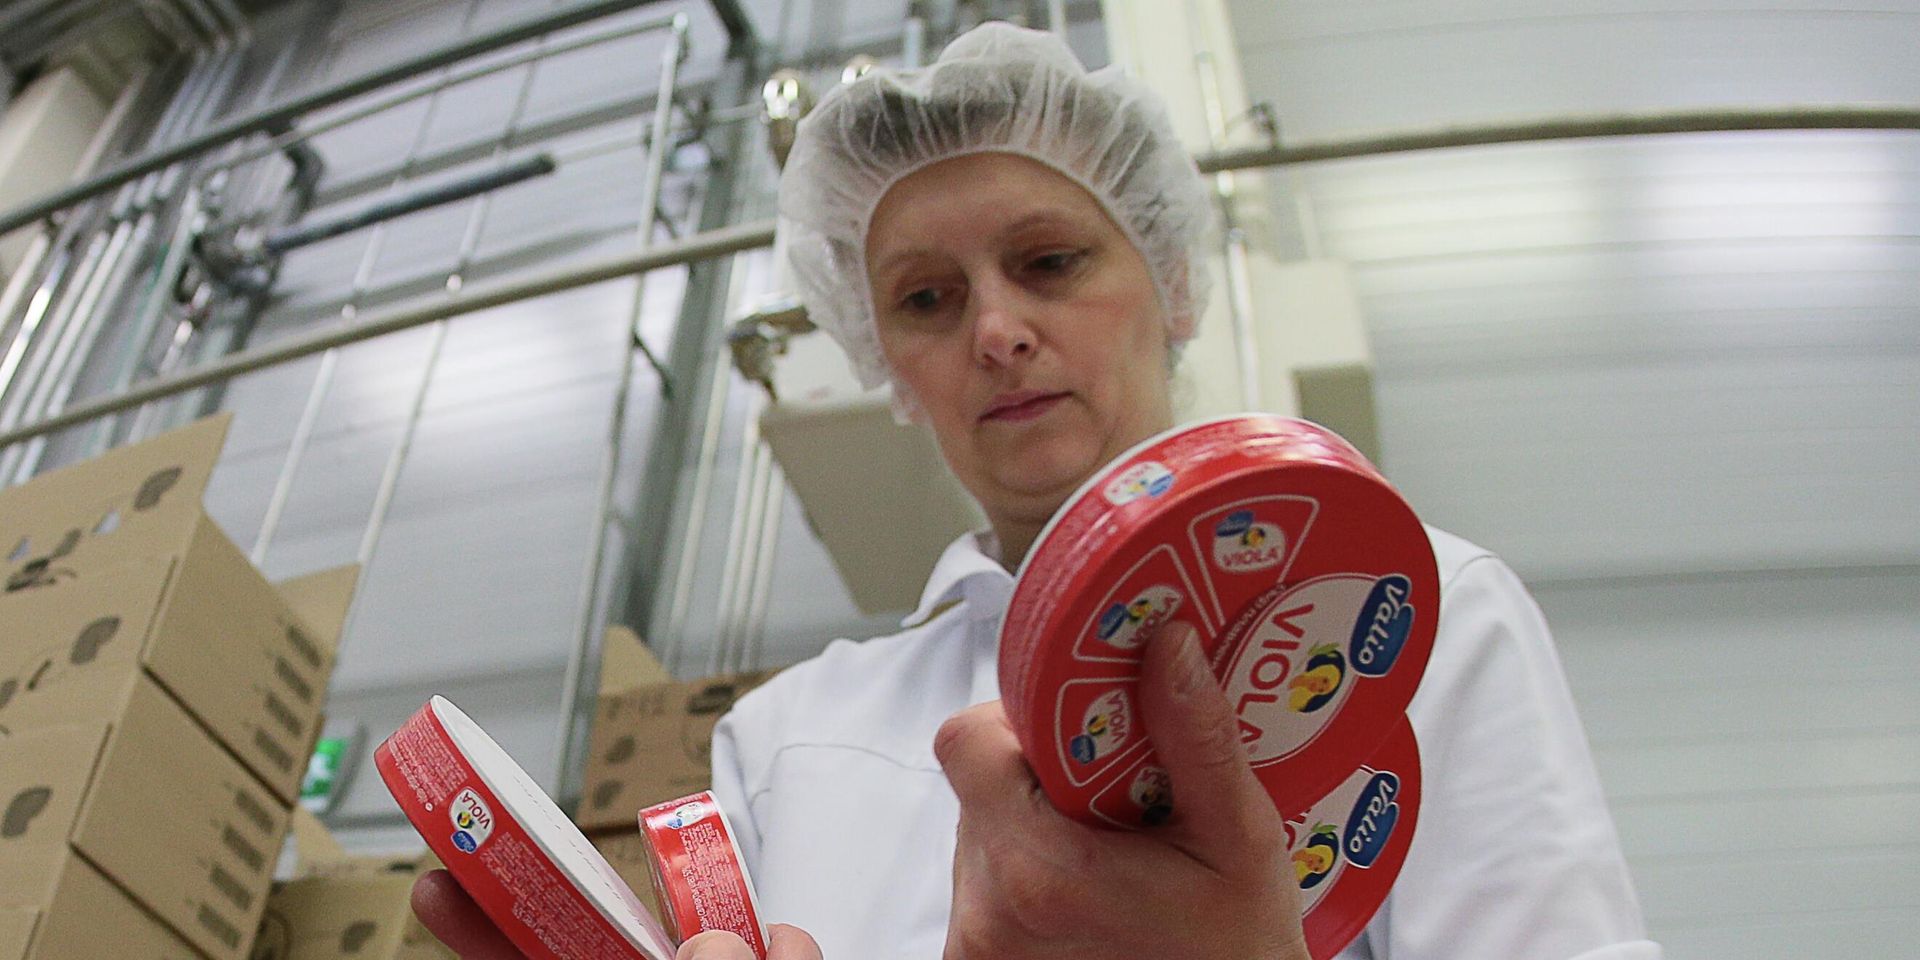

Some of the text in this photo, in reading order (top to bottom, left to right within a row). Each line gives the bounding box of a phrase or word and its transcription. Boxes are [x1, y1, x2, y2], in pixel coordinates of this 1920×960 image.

[1358, 583, 1405, 665] Valio
[1236, 603, 1315, 744] VIOLA
[461, 792, 491, 830] VIOLA
[1350, 780, 1394, 853] Valio
